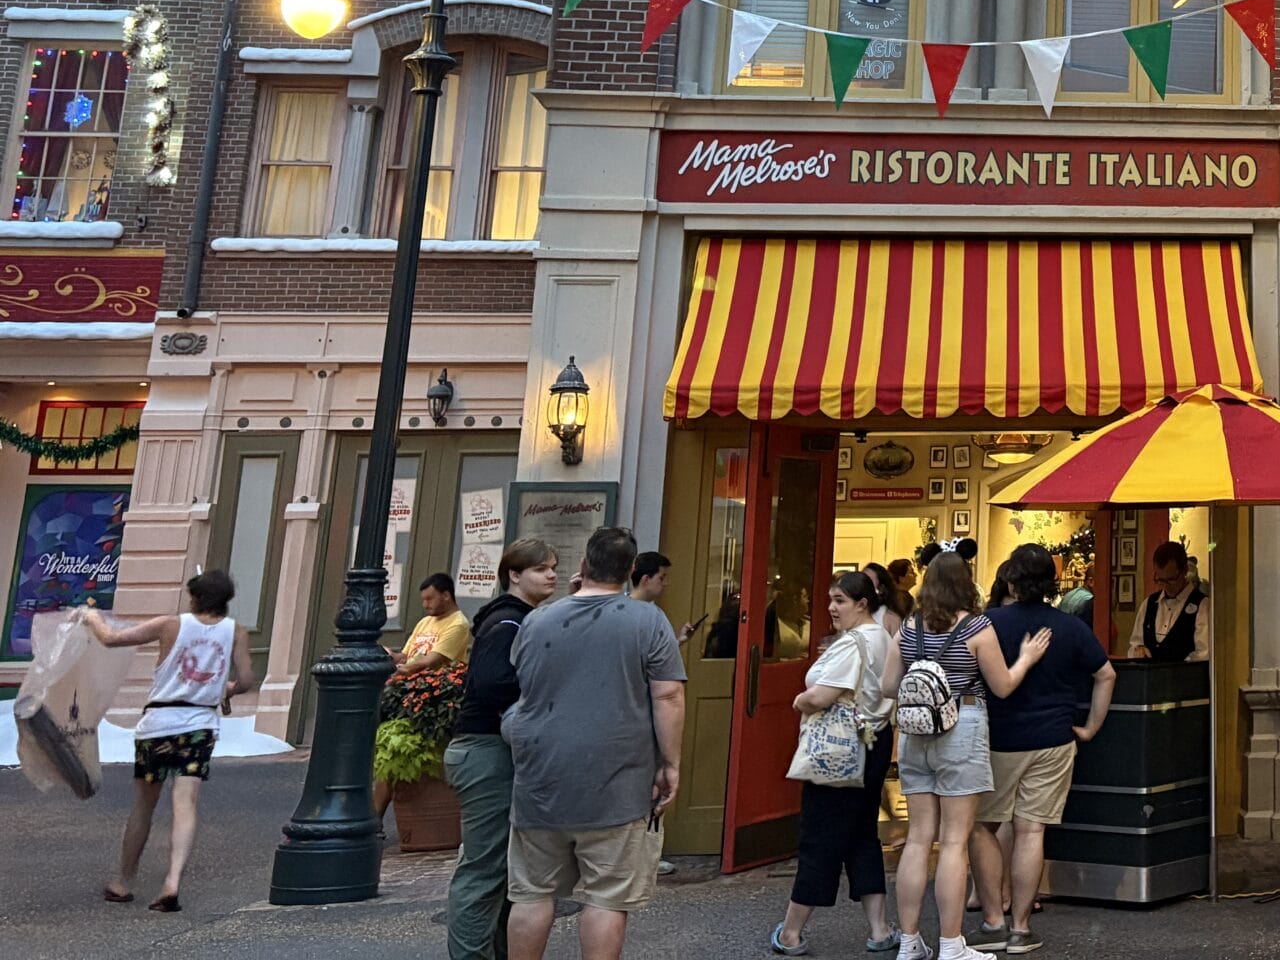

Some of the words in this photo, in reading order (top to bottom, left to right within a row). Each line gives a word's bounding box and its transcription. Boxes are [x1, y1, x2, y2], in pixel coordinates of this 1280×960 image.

[845, 11, 860, 26] Now
[866, 21, 880, 30] You
[856, 60, 895, 79] HOP
[678, 138, 794, 175] Mama
[849, 148, 1072, 185] RISTORANTE
[1088, 152, 1258, 189] ITALIANO
[706, 150, 837, 196] Melrose's
[524, 503, 563, 517] Mama
[39, 551, 120, 581] Wonderful
